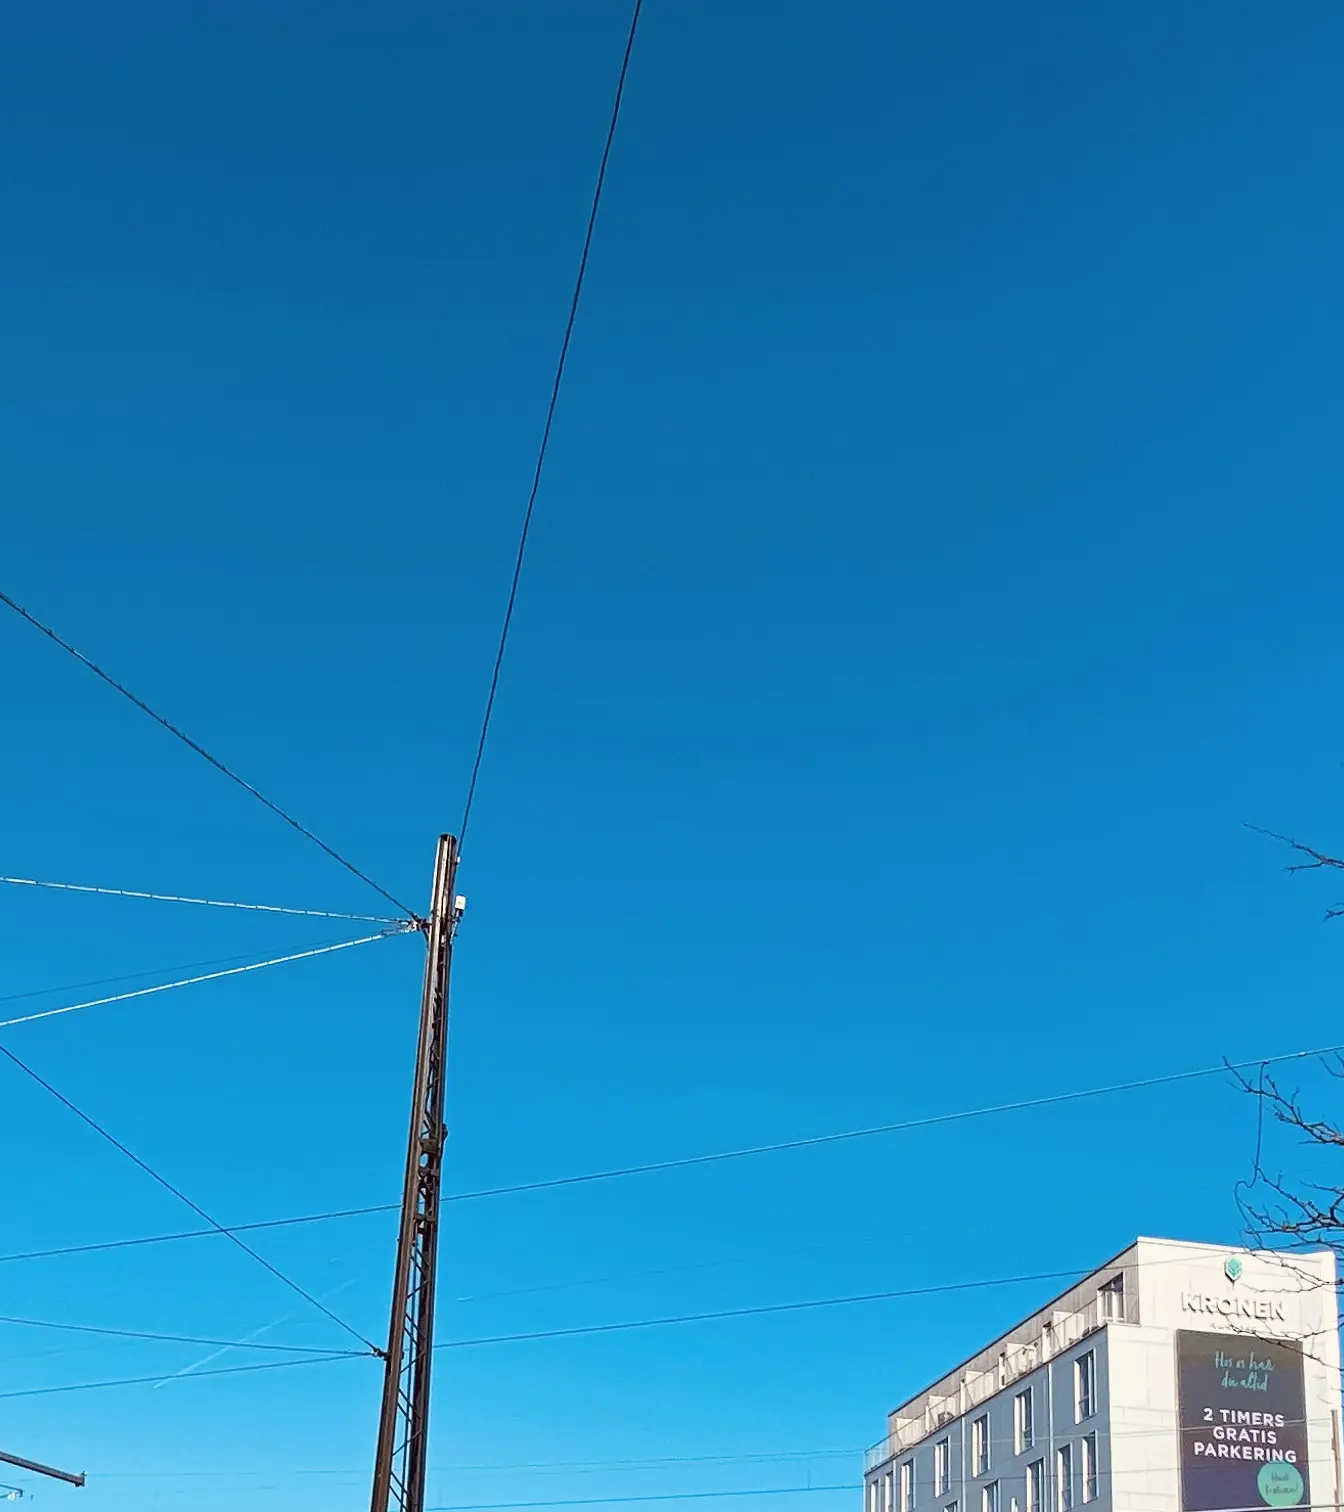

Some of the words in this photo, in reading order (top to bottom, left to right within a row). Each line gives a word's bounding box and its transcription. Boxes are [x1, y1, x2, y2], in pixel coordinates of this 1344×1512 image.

[1181, 1291, 1285, 1321] KRONEN
[1203, 1407, 1213, 1421] 2
[1219, 1409, 1285, 1427] TIMERS
[1213, 1426, 1277, 1444] GRATIS
[1193, 1441, 1297, 1463] PARKERING
